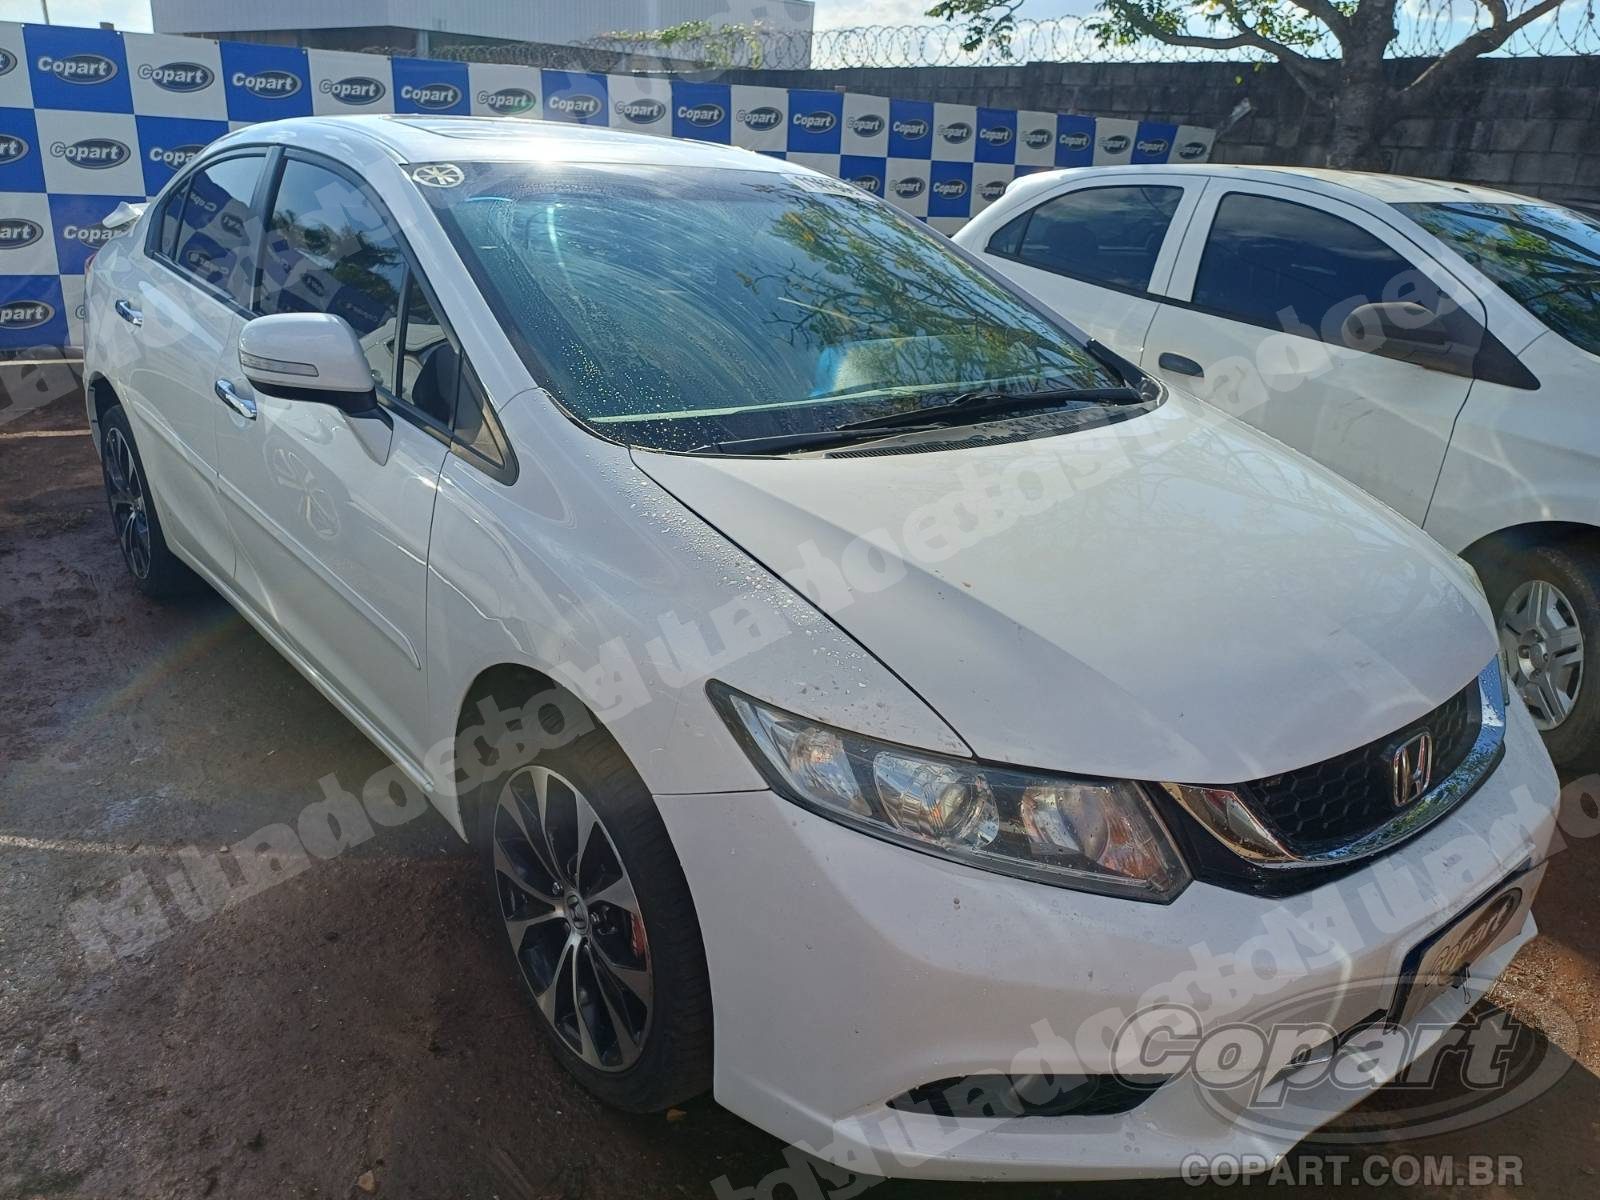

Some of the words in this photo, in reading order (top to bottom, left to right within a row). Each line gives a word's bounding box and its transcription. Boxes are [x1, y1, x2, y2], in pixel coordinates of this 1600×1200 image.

[37, 57, 108, 76] Copart
[137, 63, 203, 84] Copart
[232, 72, 293, 91] Copart
[319, 79, 376, 97] Copart
[401, 86, 454, 103] Copart
[477, 90, 527, 107] Copart
[549, 96, 594, 112] Copart
[615, 101, 659, 117] Copart
[677, 106, 720, 121] Copart
[736, 110, 777, 125] Copart
[793, 113, 832, 128] Copart
[893, 120, 925, 135] Copart
[50, 141, 119, 160] Copart
[150, 147, 196, 165] Copa
[0, 223, 30, 239] art
[64, 225, 113, 242] Copa
[0, 306, 43, 322] part
